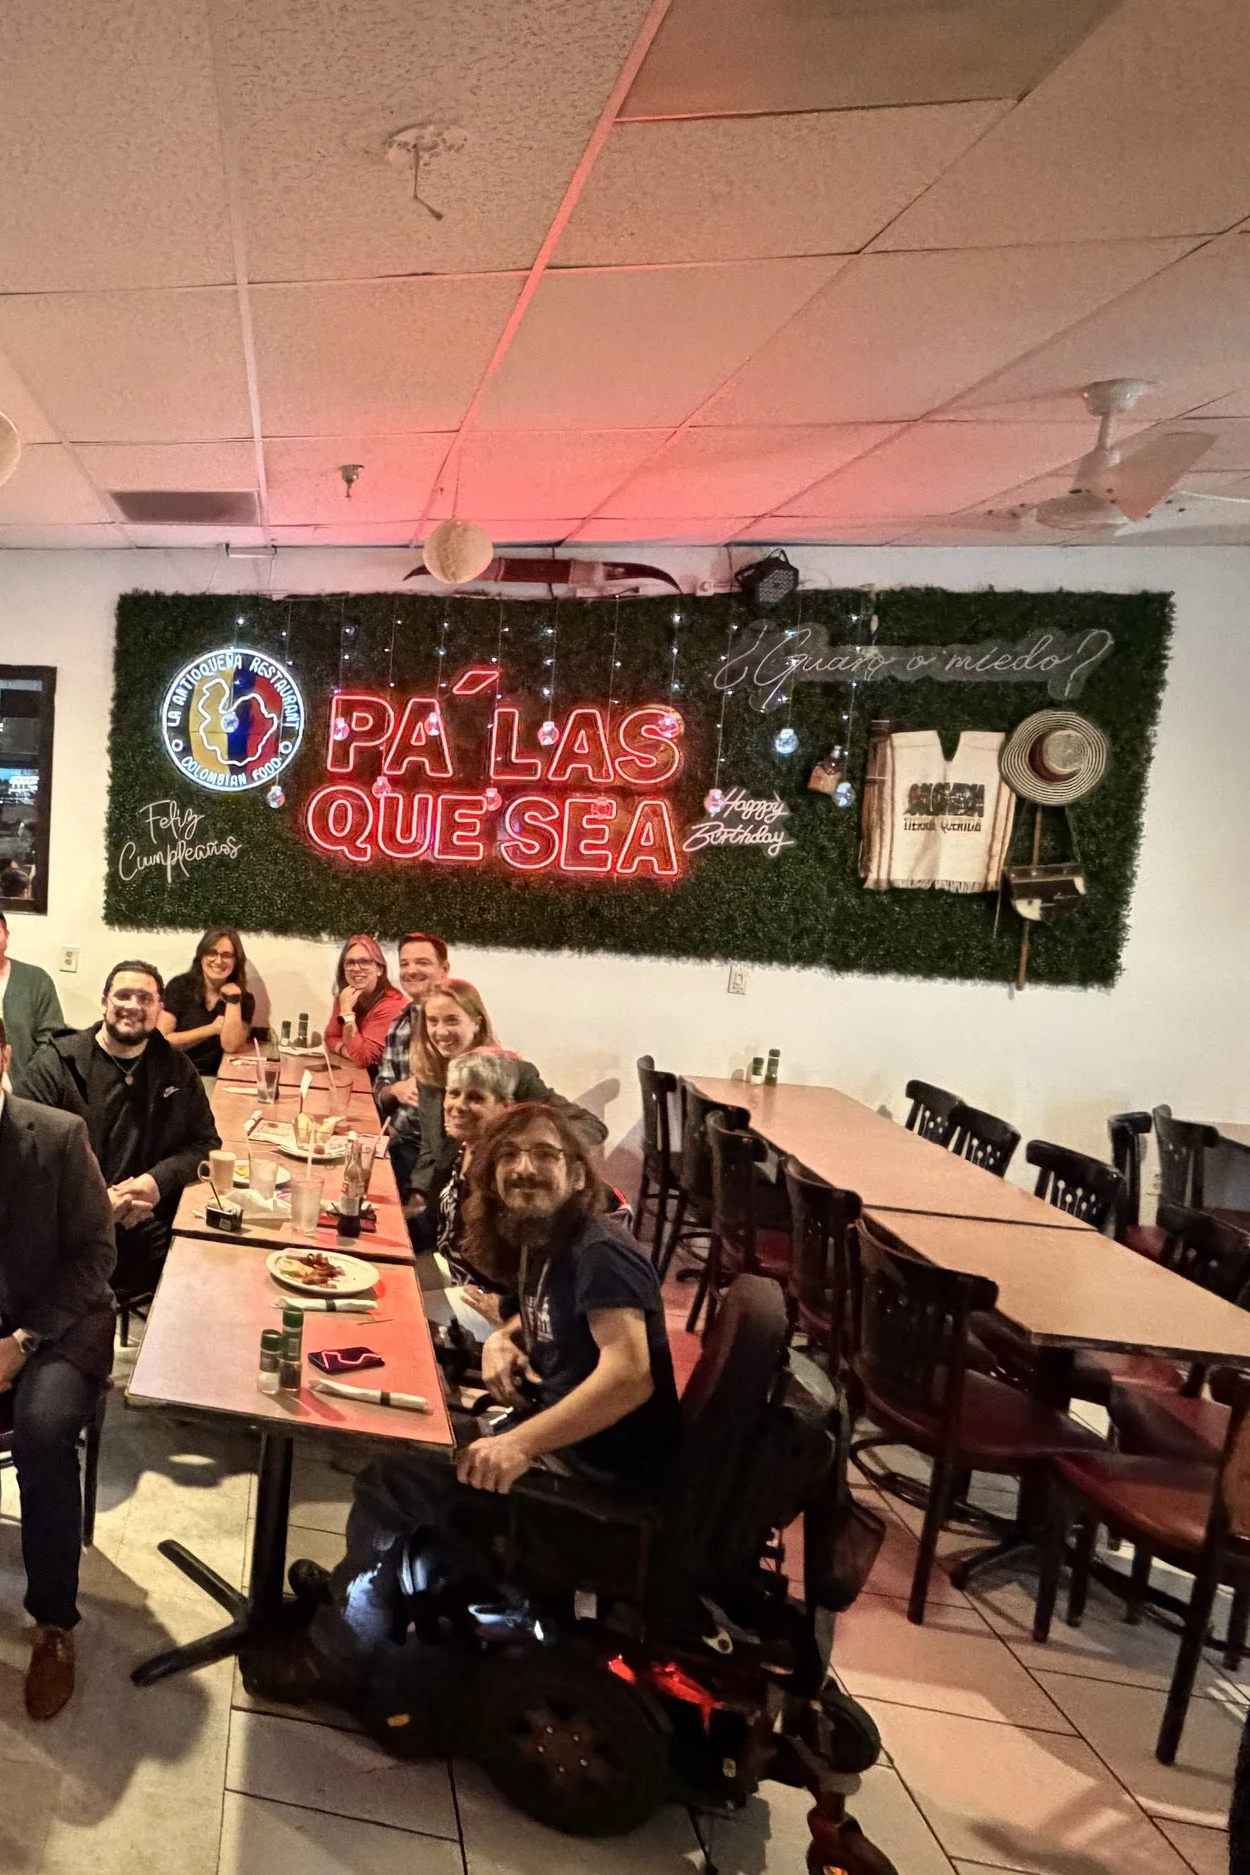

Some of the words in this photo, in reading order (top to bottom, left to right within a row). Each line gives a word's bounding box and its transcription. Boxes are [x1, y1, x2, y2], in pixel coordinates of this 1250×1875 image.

[906, 655, 937, 672] o
[944, 628, 1115, 697] miedo?
[168, 711, 182, 728] LA
[249, 656, 300, 730] RESTAURANT
[181, 756, 247, 788] COLOMBIAN
[252, 758, 282, 782] FOOD
[139, 799, 206, 845] Feliz
[711, 787, 789, 824] Happy
[307, 785, 488, 862] QUE
[500, 796, 679, 876] SEA
[682, 821, 795, 857] Birthday
[118, 836, 243, 884] Cumpleaños
